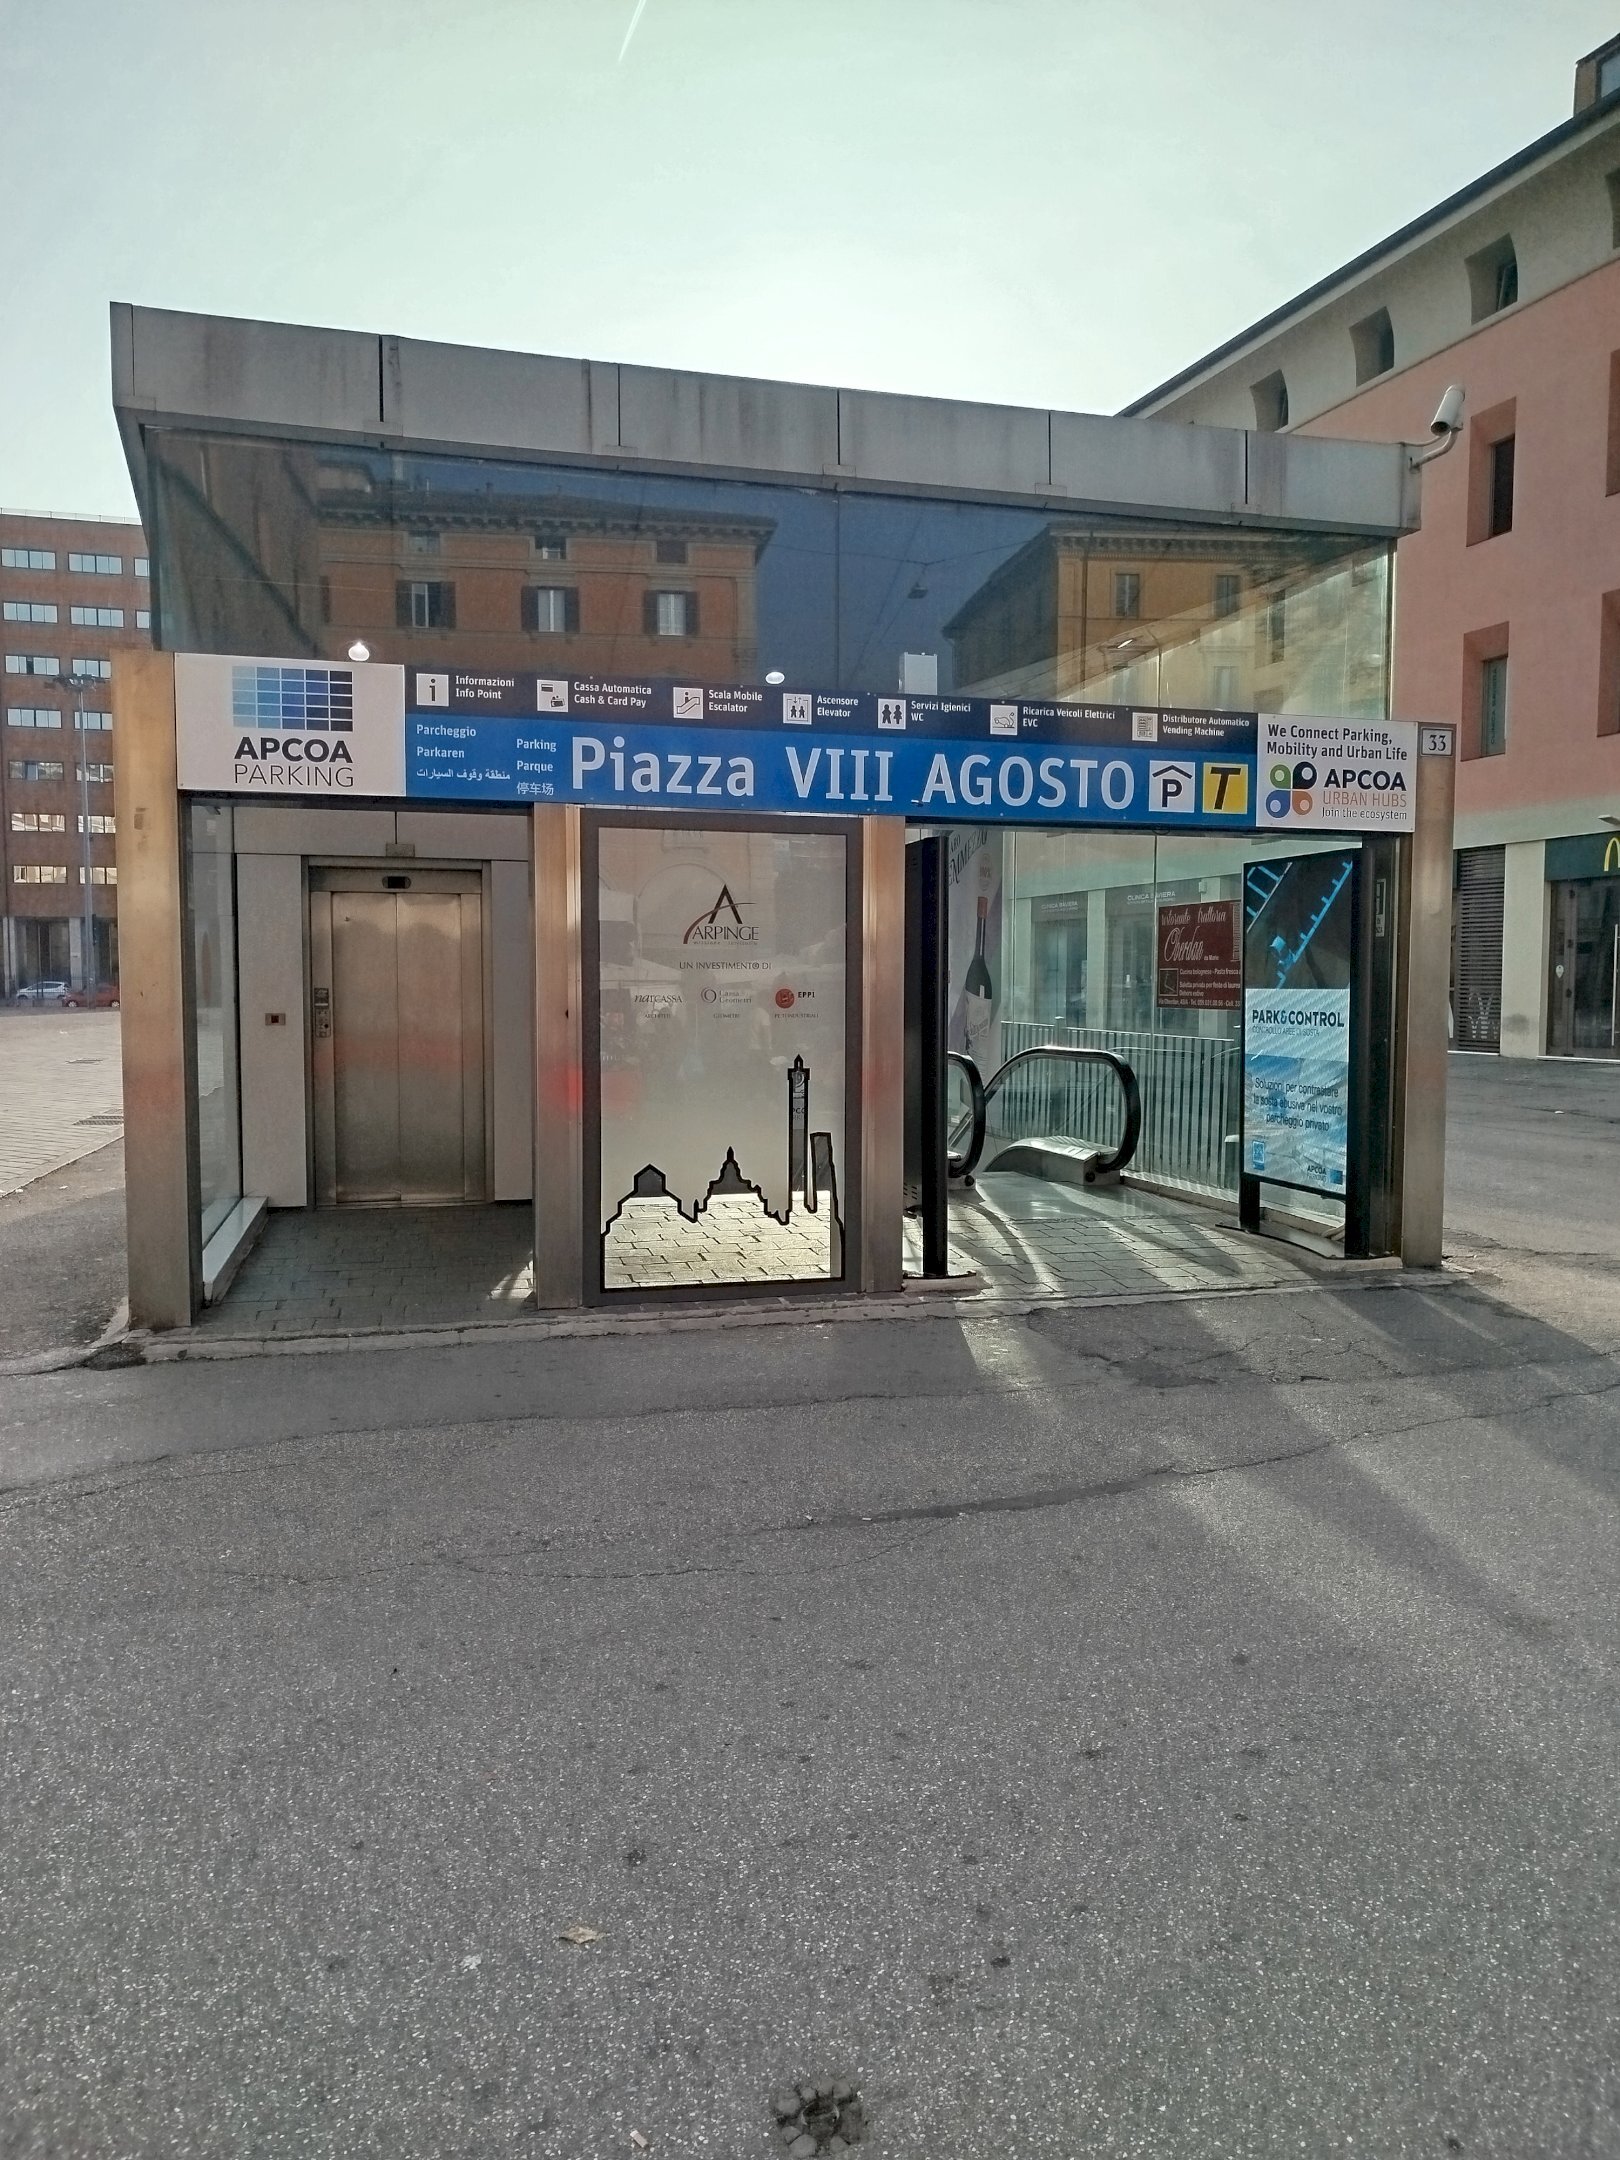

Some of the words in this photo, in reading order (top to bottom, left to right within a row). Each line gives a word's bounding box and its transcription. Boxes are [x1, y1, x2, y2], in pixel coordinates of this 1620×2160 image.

[455, 675, 515, 688] Informazioni
[574, 681, 600, 692] Cassa
[602, 683, 652, 695] Automatica
[455, 688, 475, 698] Info
[477, 689, 502, 700] Point
[708, 689, 732, 700] Scala
[733, 690, 763, 702] Mobile
[817, 695, 859, 706] Ascensore
[574, 694, 596, 705] Cash
[598, 696, 605, 705] &
[607, 696, 628, 706] Card
[631, 697, 647, 709] Pay
[708, 702, 748, 713] Escalator
[911, 700, 939, 712] Servizi
[941, 702, 972, 713] Igienici
[817, 707, 851, 718] Elevator
[911, 712, 924, 722] WC
[1022, 706, 1055, 717] Ricarica
[1056, 708, 1083, 719] Veicoli
[1085, 709, 1116, 720] Elettrici
[1022, 718, 1038, 728] EVC
[1162, 714, 1207, 725] Distributore
[1208, 716, 1250, 727] Automatico
[416, 724, 477, 739] Parcheggio
[1162, 725, 1193, 737] Vending
[1194, 727, 1225, 737] Machine
[1268, 723, 1287, 738] We
[1290, 725, 1339, 741] Connect
[1342, 727, 1393, 746] Parking,
[234, 736, 354, 764] APCOA
[516, 738, 557, 753] Parking
[1428, 734, 1447, 752] 33
[416, 746, 465, 759] Parkaren
[1267, 741, 1318, 759] Mobility
[1321, 744, 1343, 758] and
[1346, 745, 1382, 760] Urban
[1385, 747, 1408, 761] Life
[416, 767, 454, 781] السيارات
[516, 760, 554, 774] Parque
[572, 735, 755, 797] Piazza
[785, 746, 894, 802] VIII
[922, 753, 1135, 810] AGOSTO
[234, 764, 354, 788] PARKING
[456, 768, 483, 782] وقوف
[484, 769, 511, 781] منطقة
[1324, 768, 1407, 792] APCOA
[516, 781, 555, 796] 停车场
[1323, 790, 1367, 807] URBAN
[1372, 792, 1407, 808] HUBS
[1322, 807, 1340, 819] Join
[1342, 807, 1358, 818] the
[1359, 810, 1407, 821] ecosystem
[692, 925, 760, 941] ARPINGE
[680, 962, 693, 970] UN
[762, 962, 772, 970] DI
[1252, 1009, 1345, 1028] PARK&CONTROL
[1254, 1078, 1282, 1091] Soluzioni
[1285, 1083, 1298, 1094] per
[1298, 1084, 1339, 1098] contrastare
[1260, 1097, 1278, 1107] sosta
[1280, 1097, 1305, 1111] abusiva
[1306, 1100, 1318, 1113] nel
[1320, 1104, 1343, 1116] vostro
[1266, 1113, 1304, 1130] parcheggio
[1305, 1119, 1330, 1132] privato
[1307, 1165, 1327, 1175] APCOA
